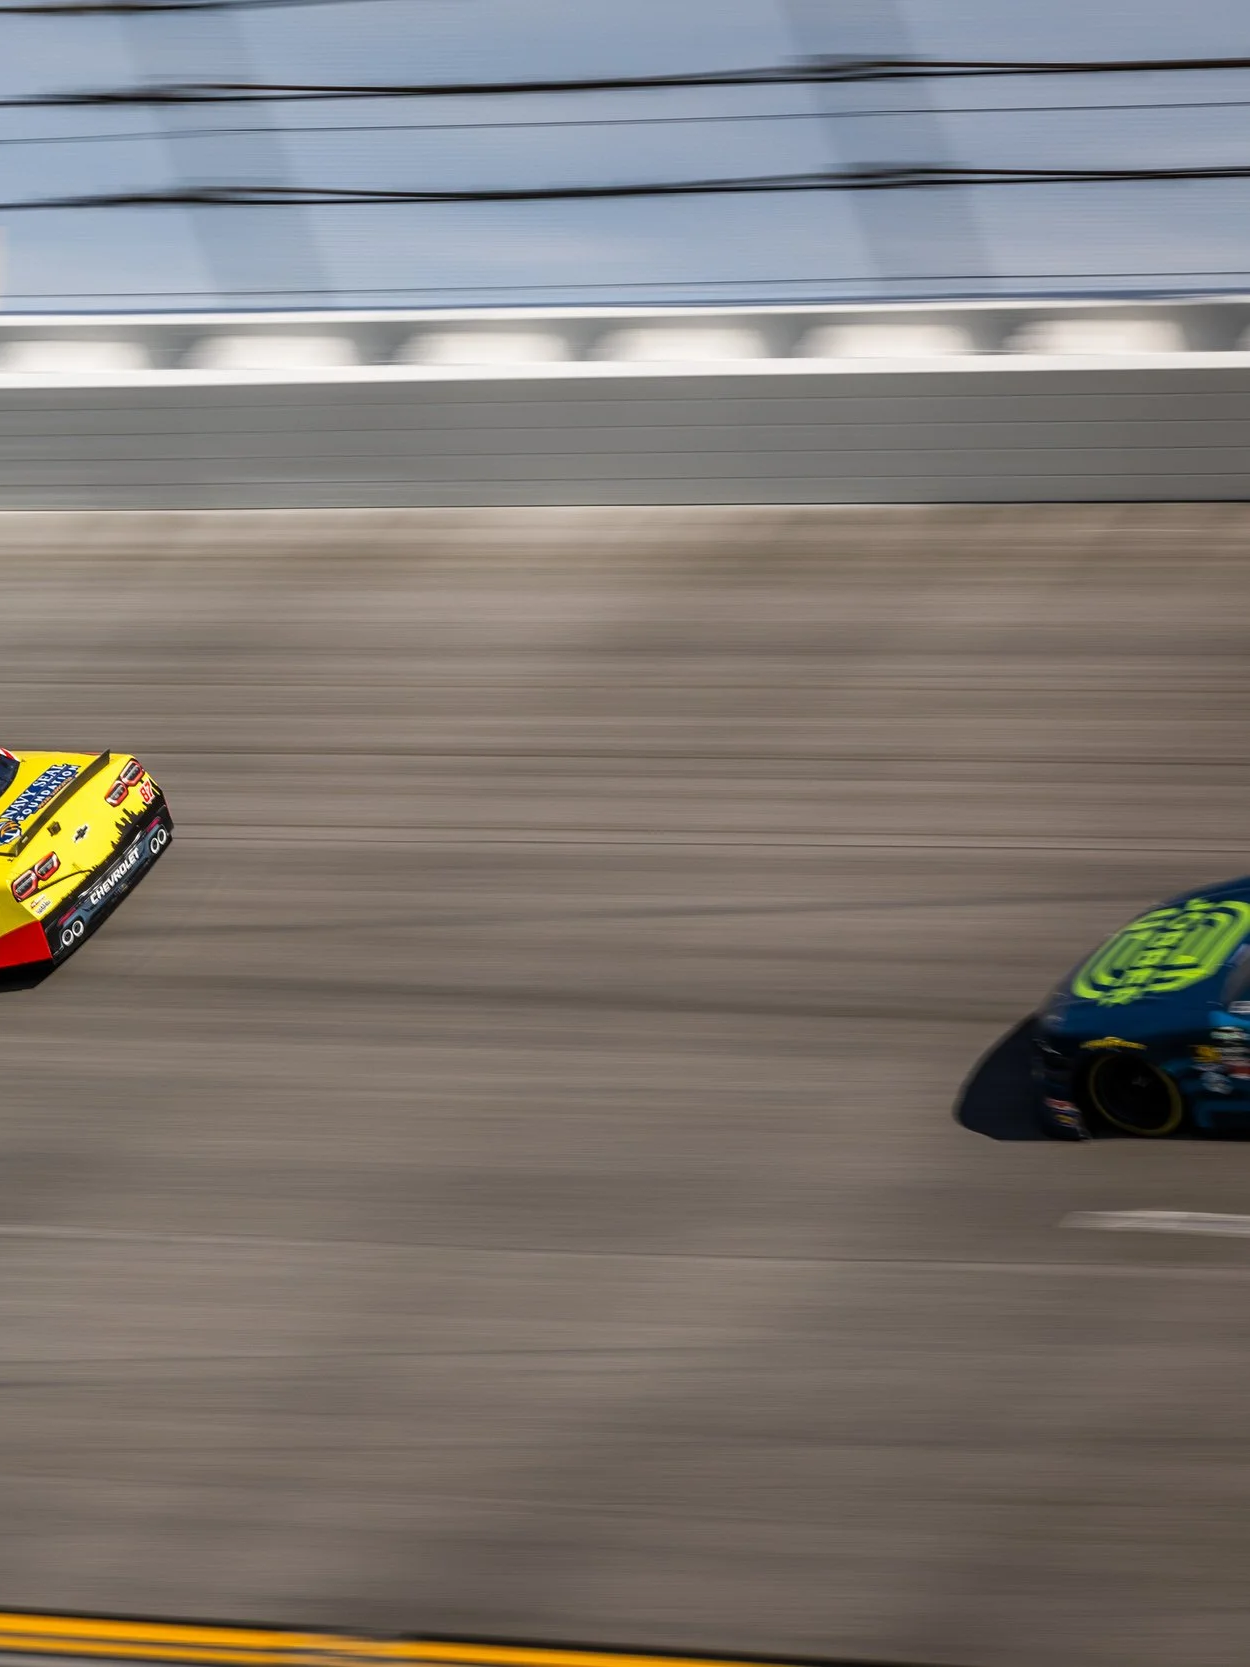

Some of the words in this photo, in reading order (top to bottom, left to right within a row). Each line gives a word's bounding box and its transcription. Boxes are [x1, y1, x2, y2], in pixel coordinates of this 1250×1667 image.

[0, 789, 36, 819] NAVY
[33, 764, 67, 787] SEAL
[16, 765, 80, 821] FOUNDATION
[139, 780, 155, 805] 87
[90, 847, 140, 905] CHEVROLET
